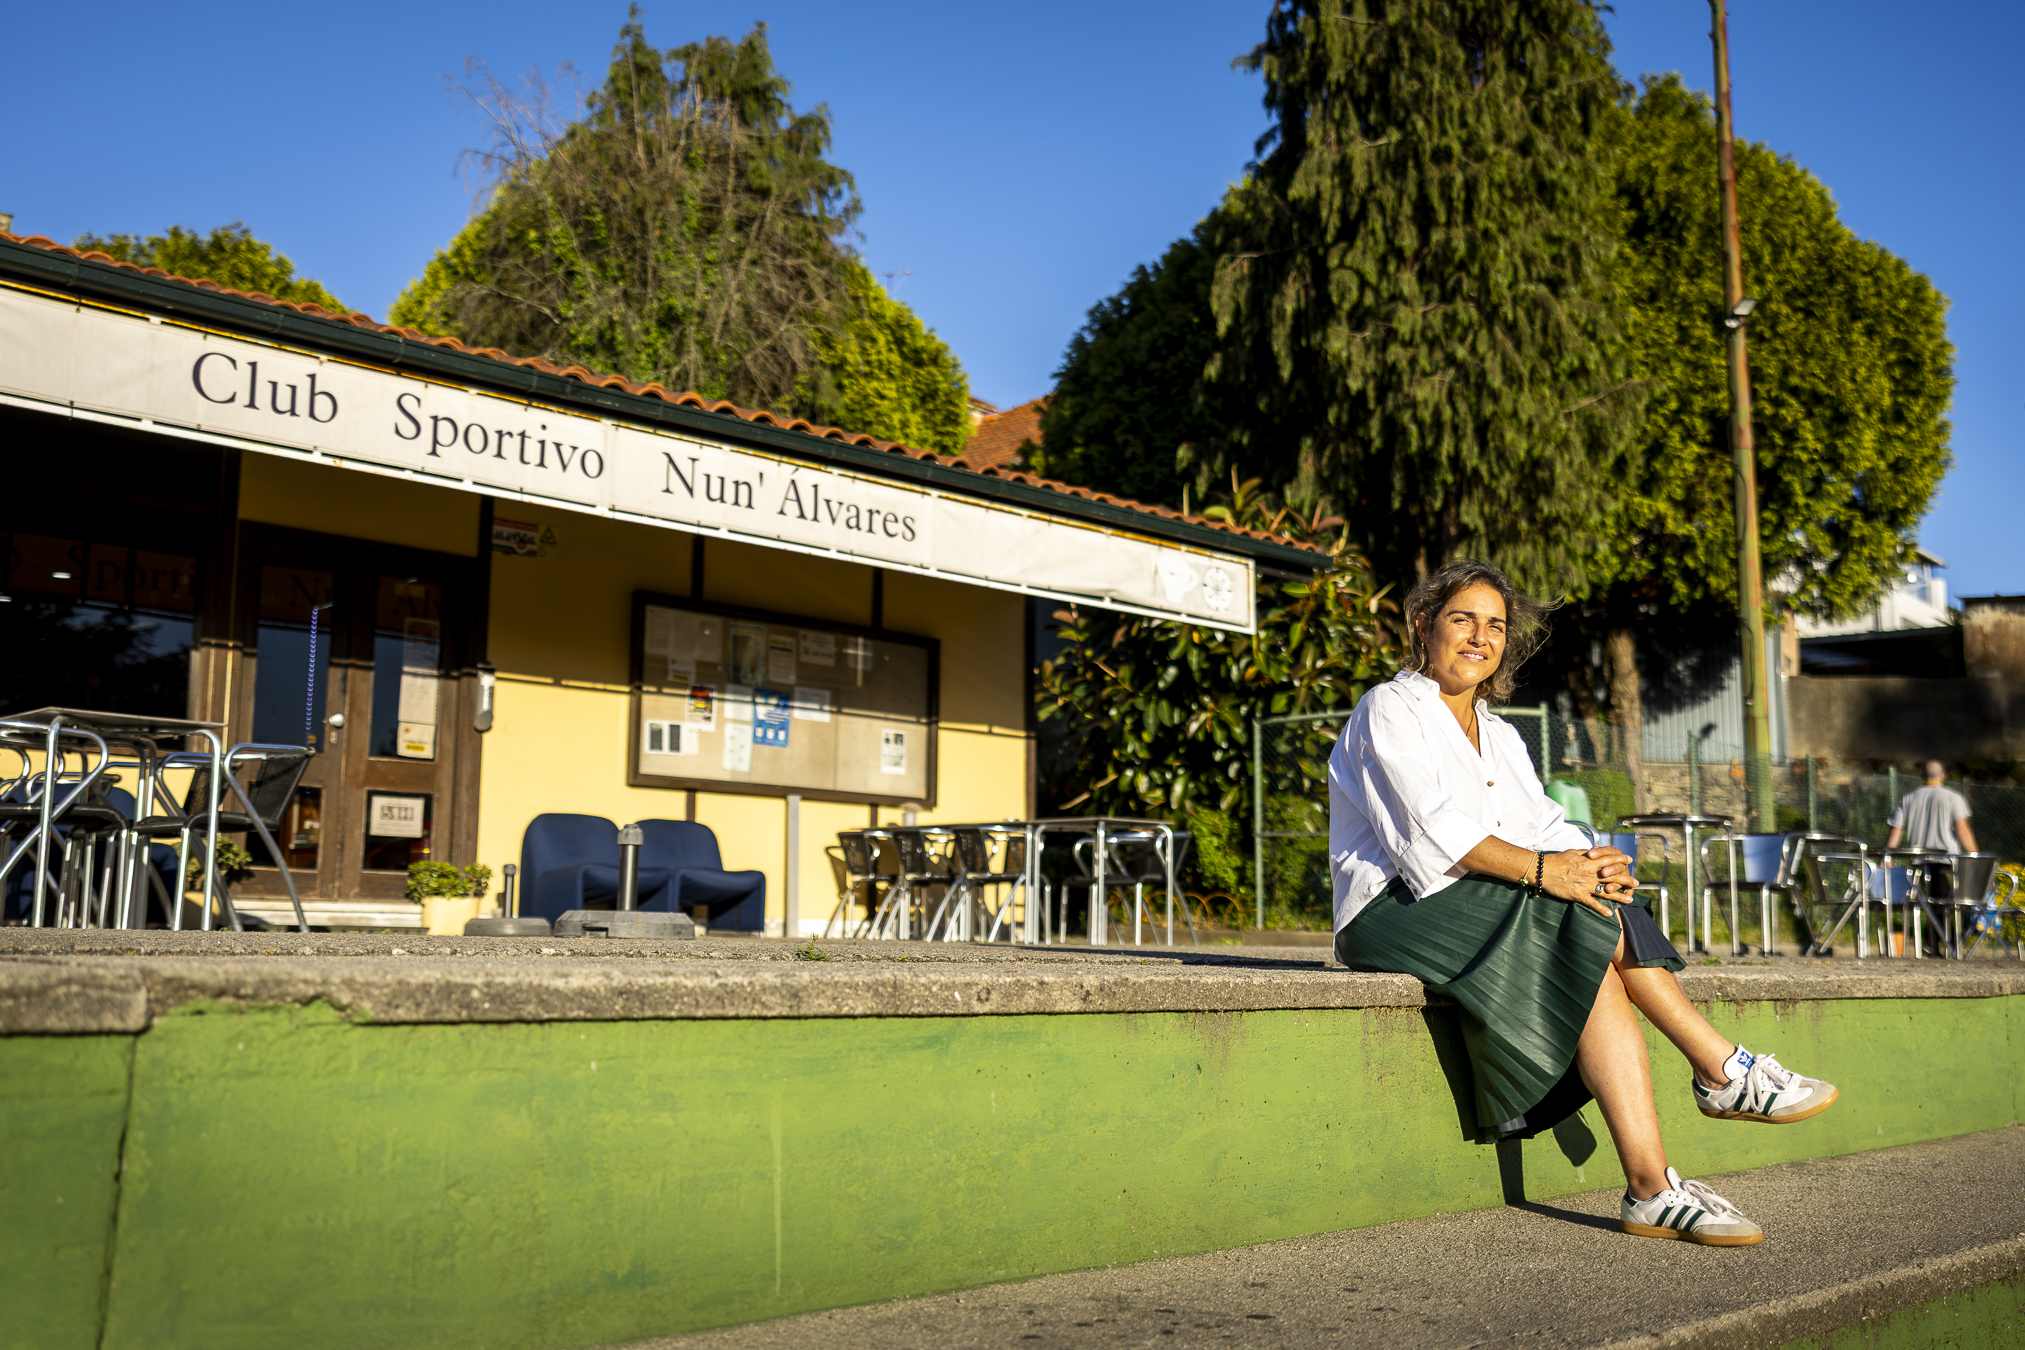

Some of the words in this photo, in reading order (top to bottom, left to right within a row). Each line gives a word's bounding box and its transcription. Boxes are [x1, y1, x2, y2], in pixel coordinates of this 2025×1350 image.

[192, 352, 338, 423] Club
[394, 393, 604, 478] Sportivo
[661, 452, 764, 510] Nun'
[776, 467, 917, 542] Álvares
